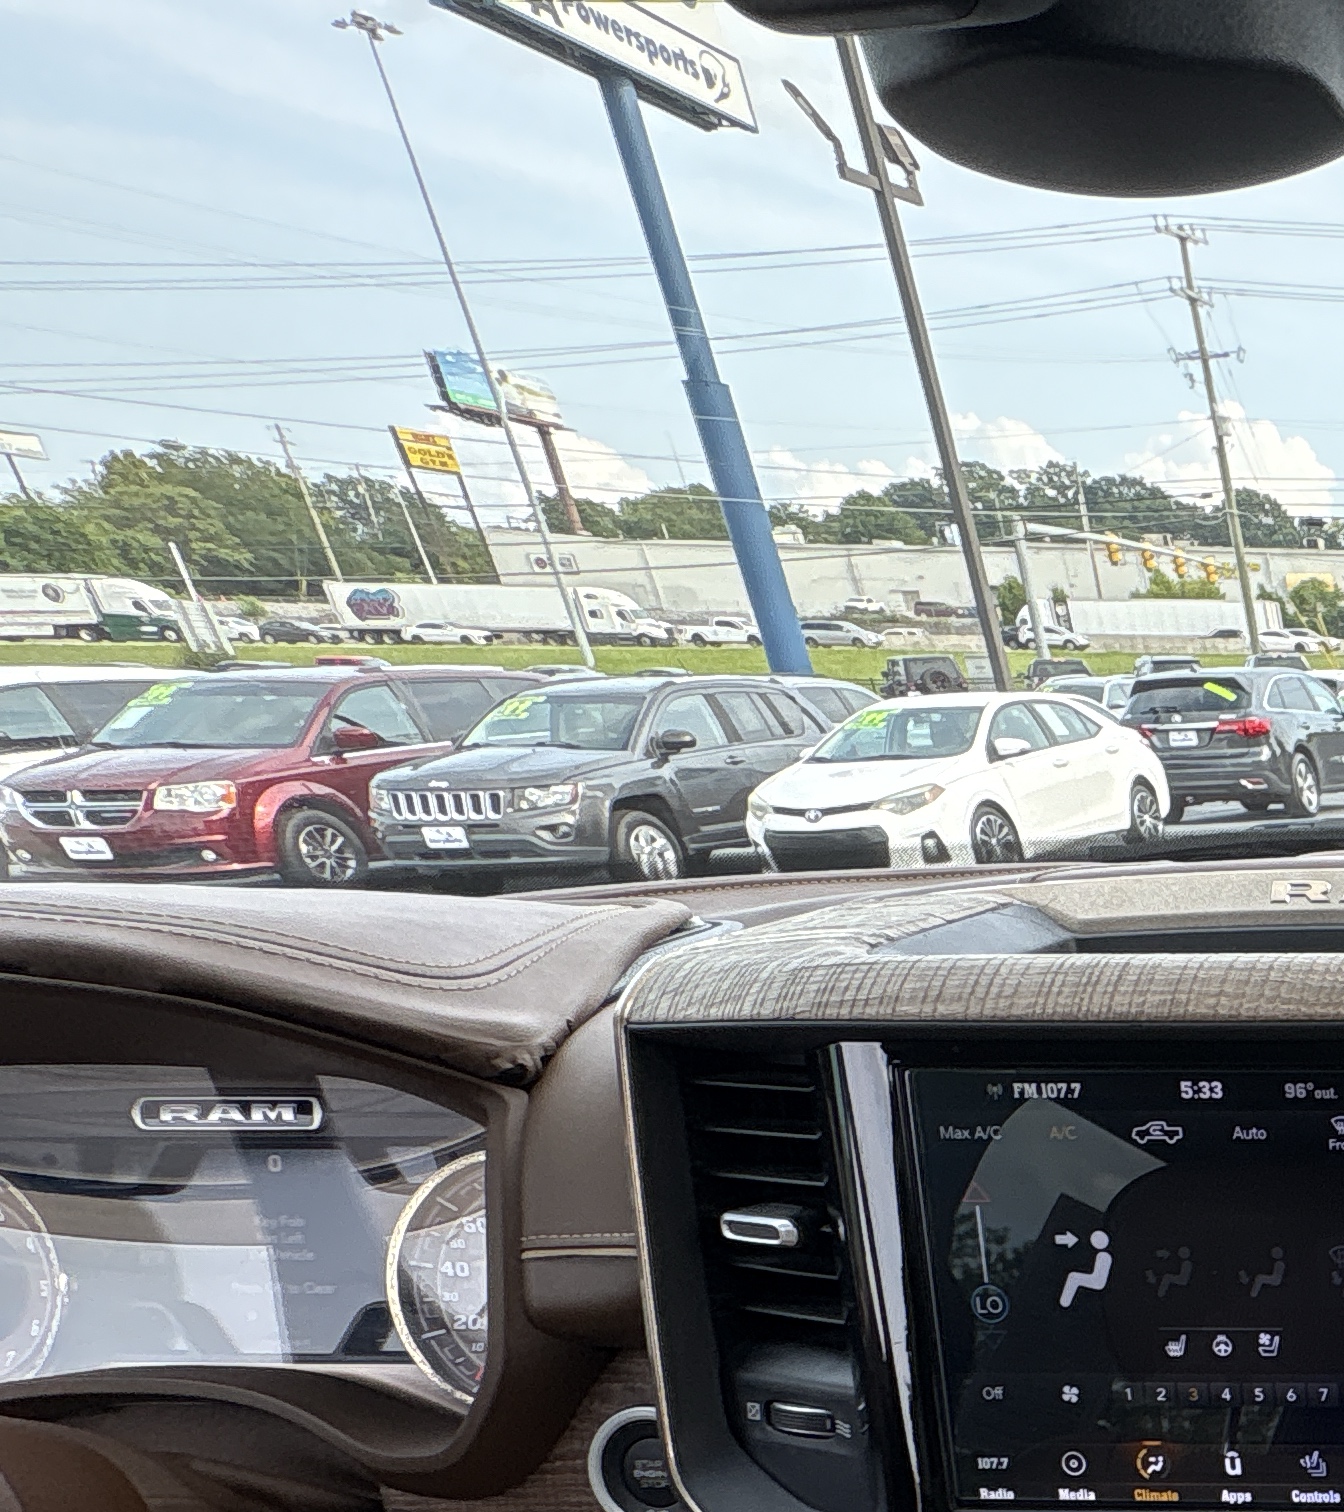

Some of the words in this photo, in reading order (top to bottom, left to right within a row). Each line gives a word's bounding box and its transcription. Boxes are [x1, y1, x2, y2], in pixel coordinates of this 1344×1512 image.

[1012, 1082, 1039, 1099] FM
[1041, 1082, 1082, 1099] 107.7
[1180, 1080, 1224, 1100] 5:33
[158, 1102, 299, 1124] RAM
[939, 1125, 971, 1140] Max
[974, 1125, 1003, 1141] A/C
[1049, 1125, 1079, 1140] A/C
[1232, 1125, 1267, 1140] Auto
[267, 1154, 282, 1172] 0
[440, 1261, 470, 1278] 40
[975, 1296, 1003, 1314] LO
[982, 1386, 1004, 1400] Off
[1124, 1388, 1133, 1401] 1
[1156, 1388, 1167, 1401] 2
[1188, 1388, 1199, 1401] 3
[1221, 1388, 1232, 1401] 4
[1253, 1388, 1265, 1401] 5
[1286, 1388, 1297, 1402] 6
[1318, 1388, 1329, 1401] 7
[977, 1457, 1009, 1470] 107.7
[633, 1470, 668, 1478] ENGIN
[979, 1488, 1015, 1501] Radio
[1058, 1488, 1096, 1501] Media
[1134, 1489, 1179, 1501] Climate
[1221, 1490, 1252, 1505] Apps
[1291, 1490, 1341, 1503] Controls
